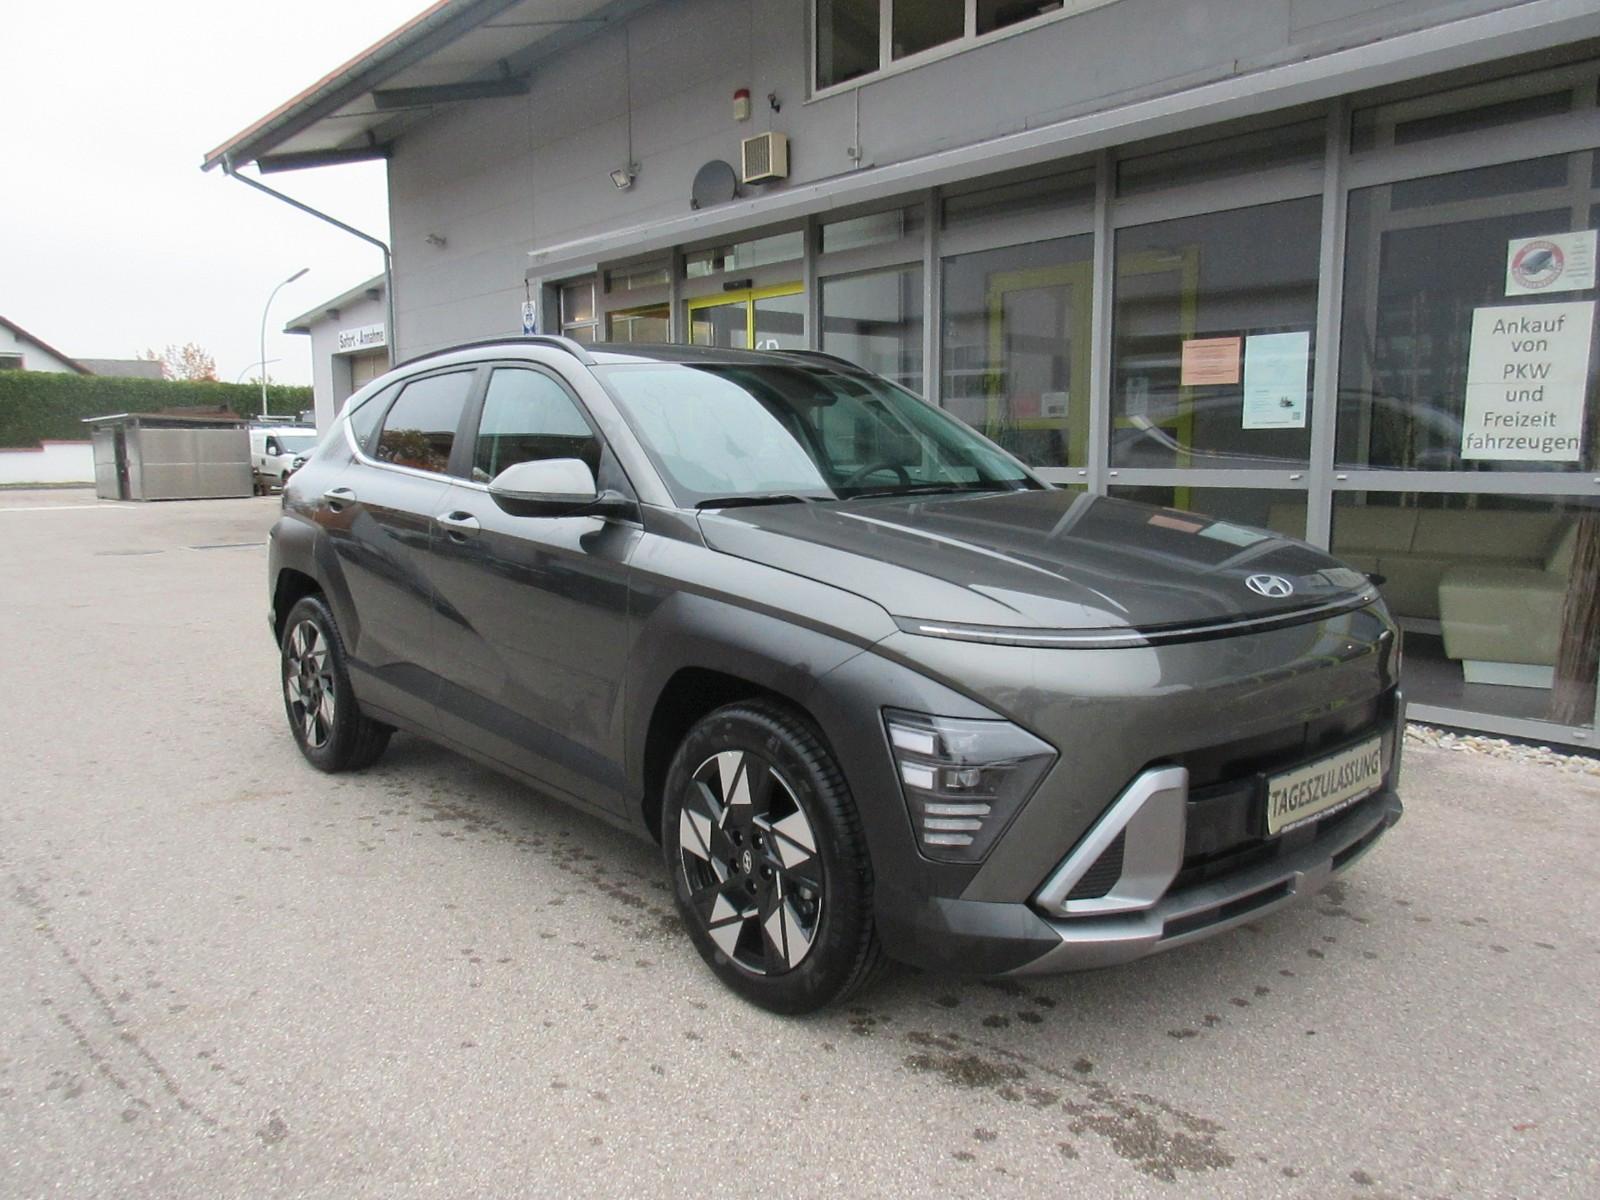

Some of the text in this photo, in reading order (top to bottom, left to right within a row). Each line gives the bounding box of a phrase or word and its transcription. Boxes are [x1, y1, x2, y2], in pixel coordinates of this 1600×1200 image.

[1492, 314, 1566, 335] Ankauf
[1511, 339, 1548, 353] von
[1503, 363, 1551, 380] PKW
[1505, 385, 1544, 403] und
[1483, 410, 1557, 428] Freizeit
[1466, 432, 1579, 454] fahrzeugen
[1270, 750, 1380, 818] TAGESZULASSUNG
